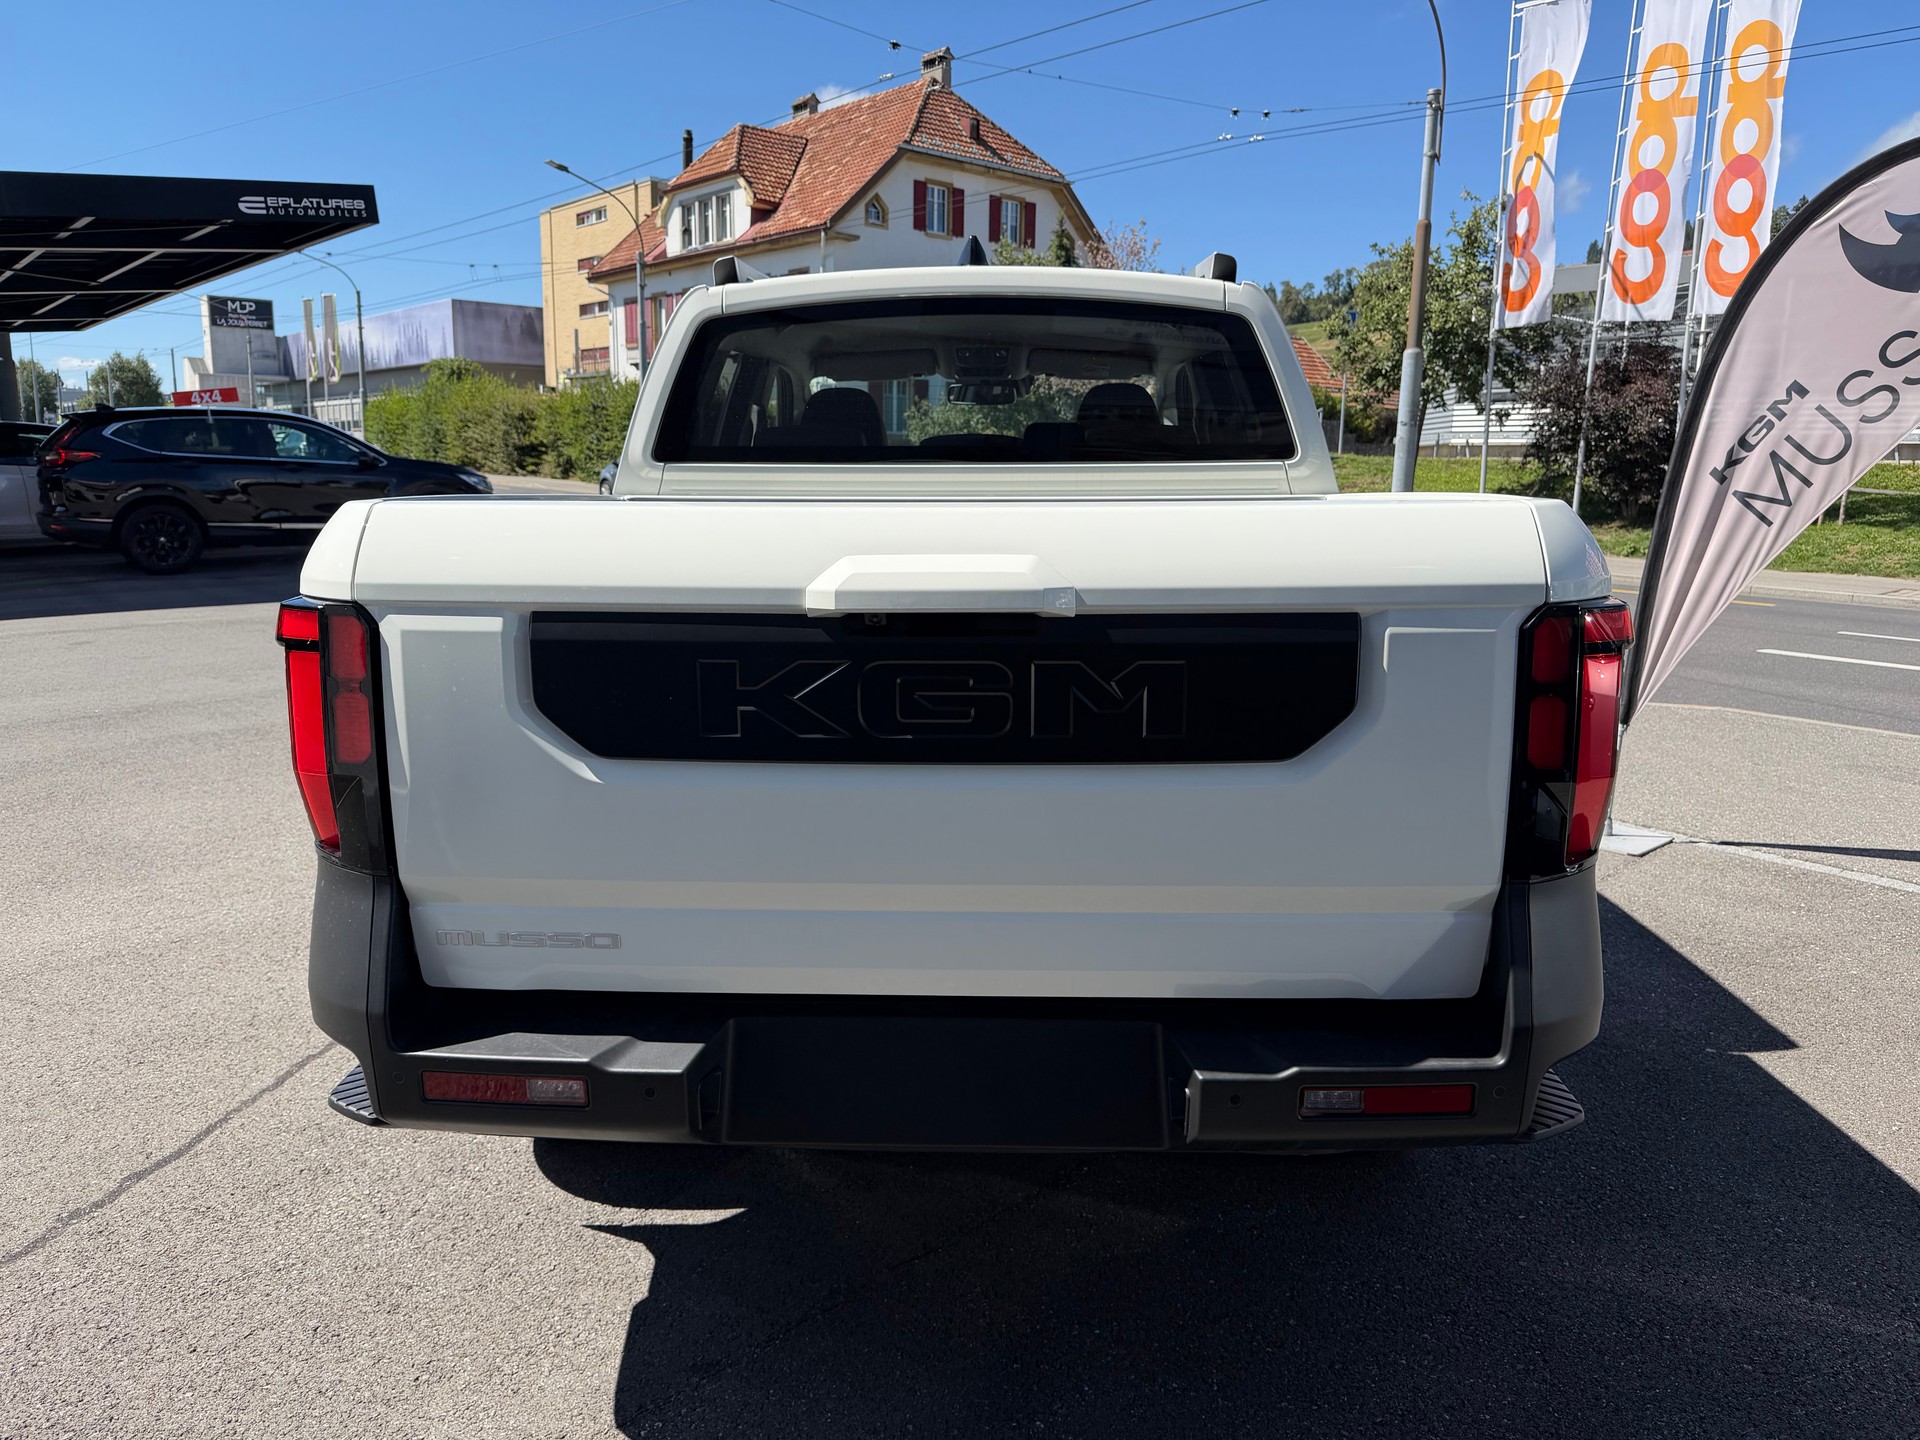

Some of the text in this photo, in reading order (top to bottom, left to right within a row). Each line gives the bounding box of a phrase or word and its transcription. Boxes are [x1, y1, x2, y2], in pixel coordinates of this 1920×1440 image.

[267, 196, 366, 210] EPLATURES
[1503, 69, 1564, 313] coop
[1611, 43, 1698, 305] coop
[1704, 19, 1785, 298] coop
[268, 207, 367, 218] AUTOMOBILES
[1709, 379, 1811, 486] KGM
[695, 659, 1189, 739] KGM
